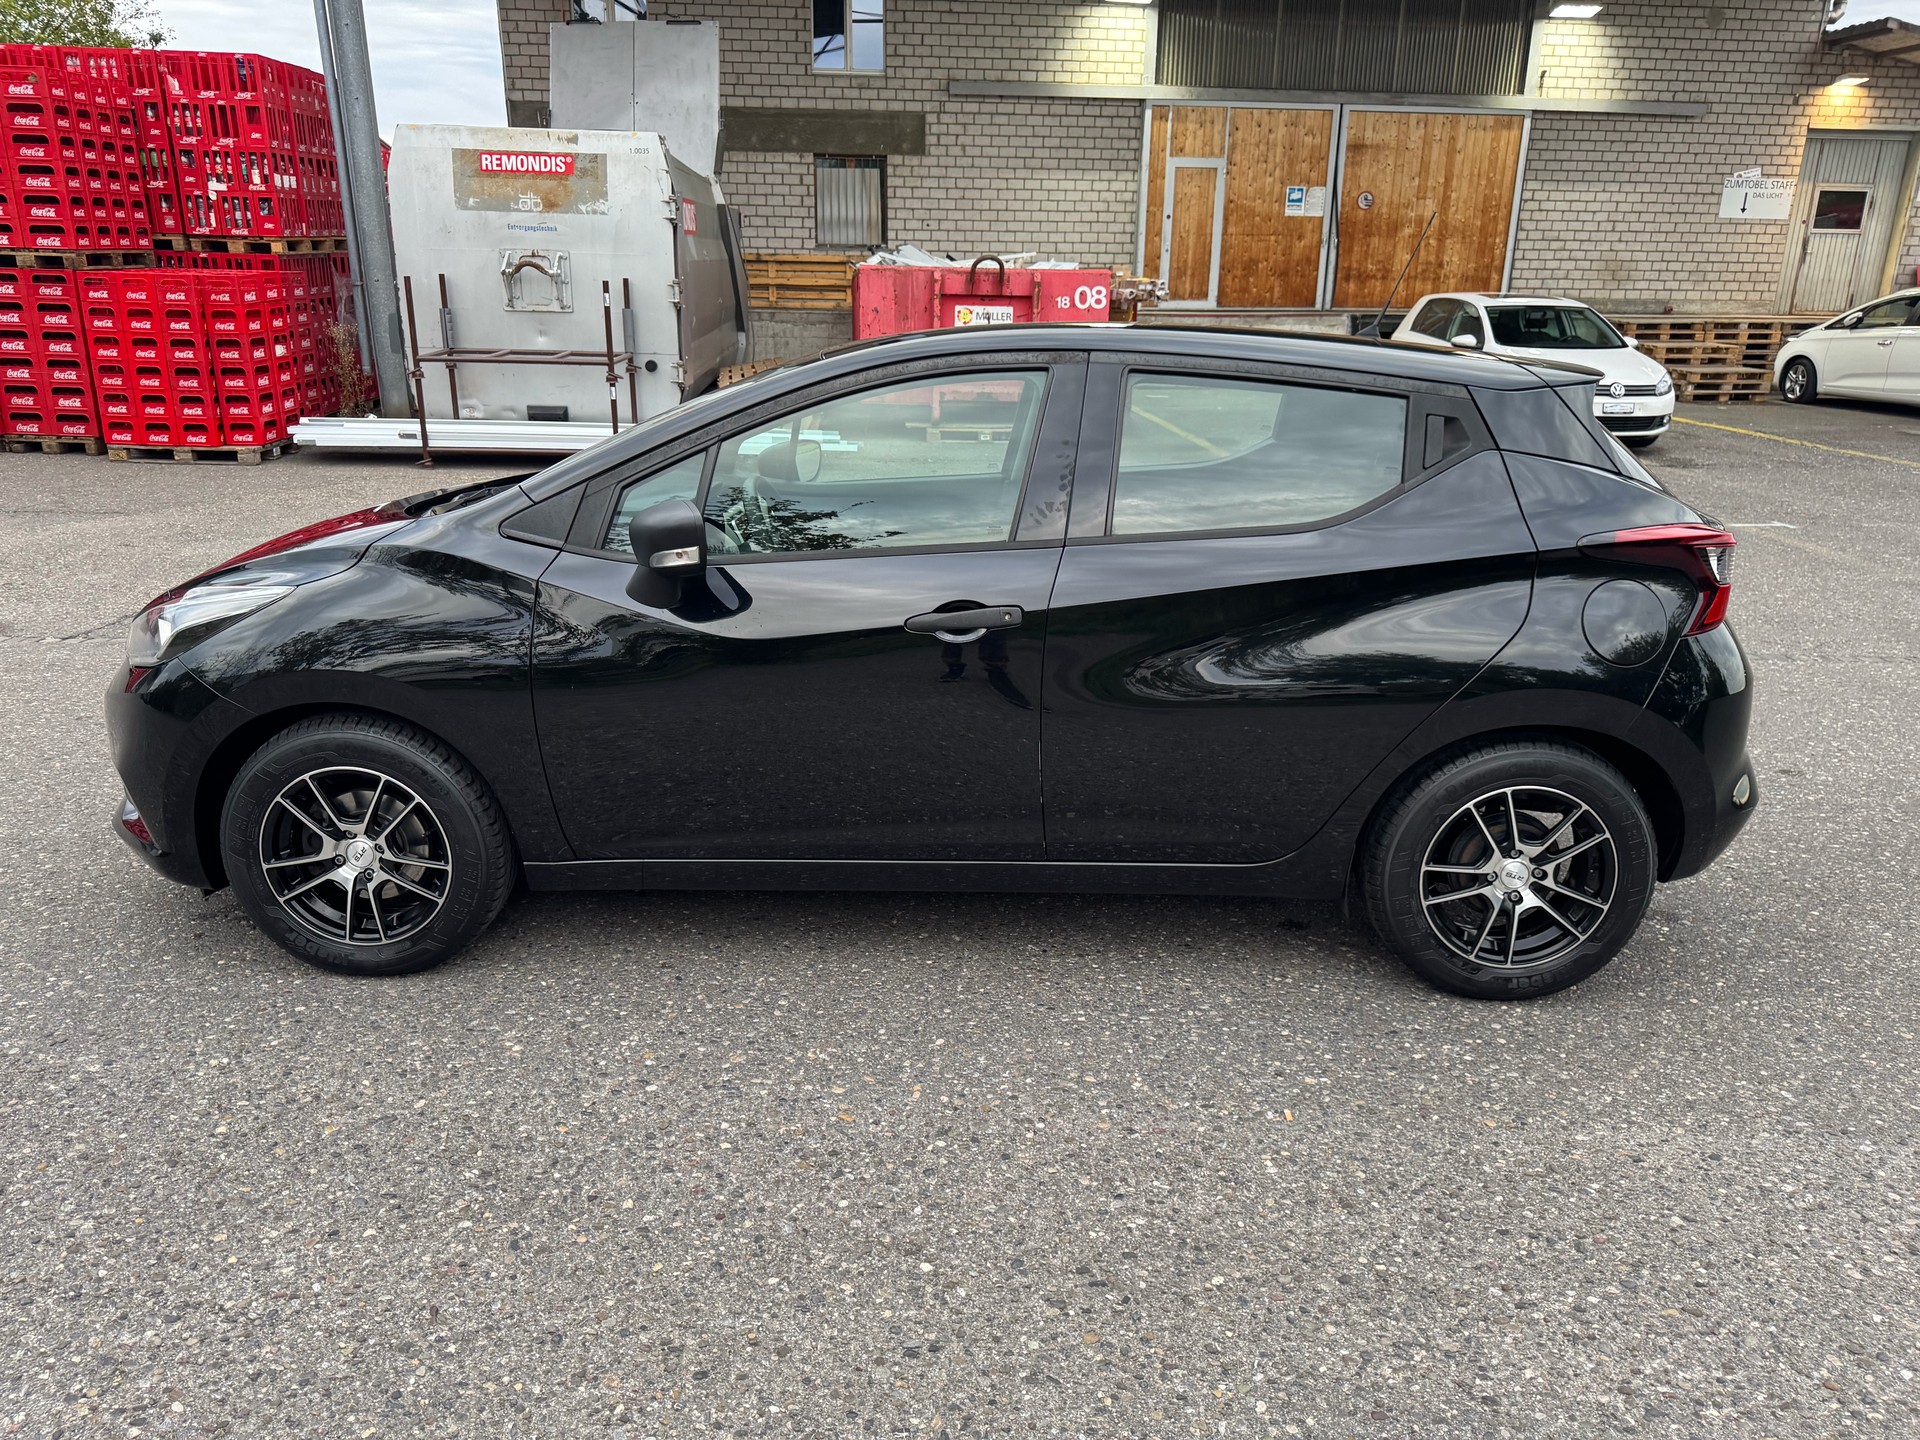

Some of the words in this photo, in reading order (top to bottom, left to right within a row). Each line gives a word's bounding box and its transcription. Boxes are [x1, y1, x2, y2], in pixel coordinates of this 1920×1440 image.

[629, 147, 650, 155] 1.0035
[481, 154, 566, 173] REMONDIS
[1724, 179, 1769, 190] ZUMTOBEL
[1771, 180, 1795, 190] STAFF
[1055, 296, 1071, 309] 18
[1074, 285, 1107, 310] 08
